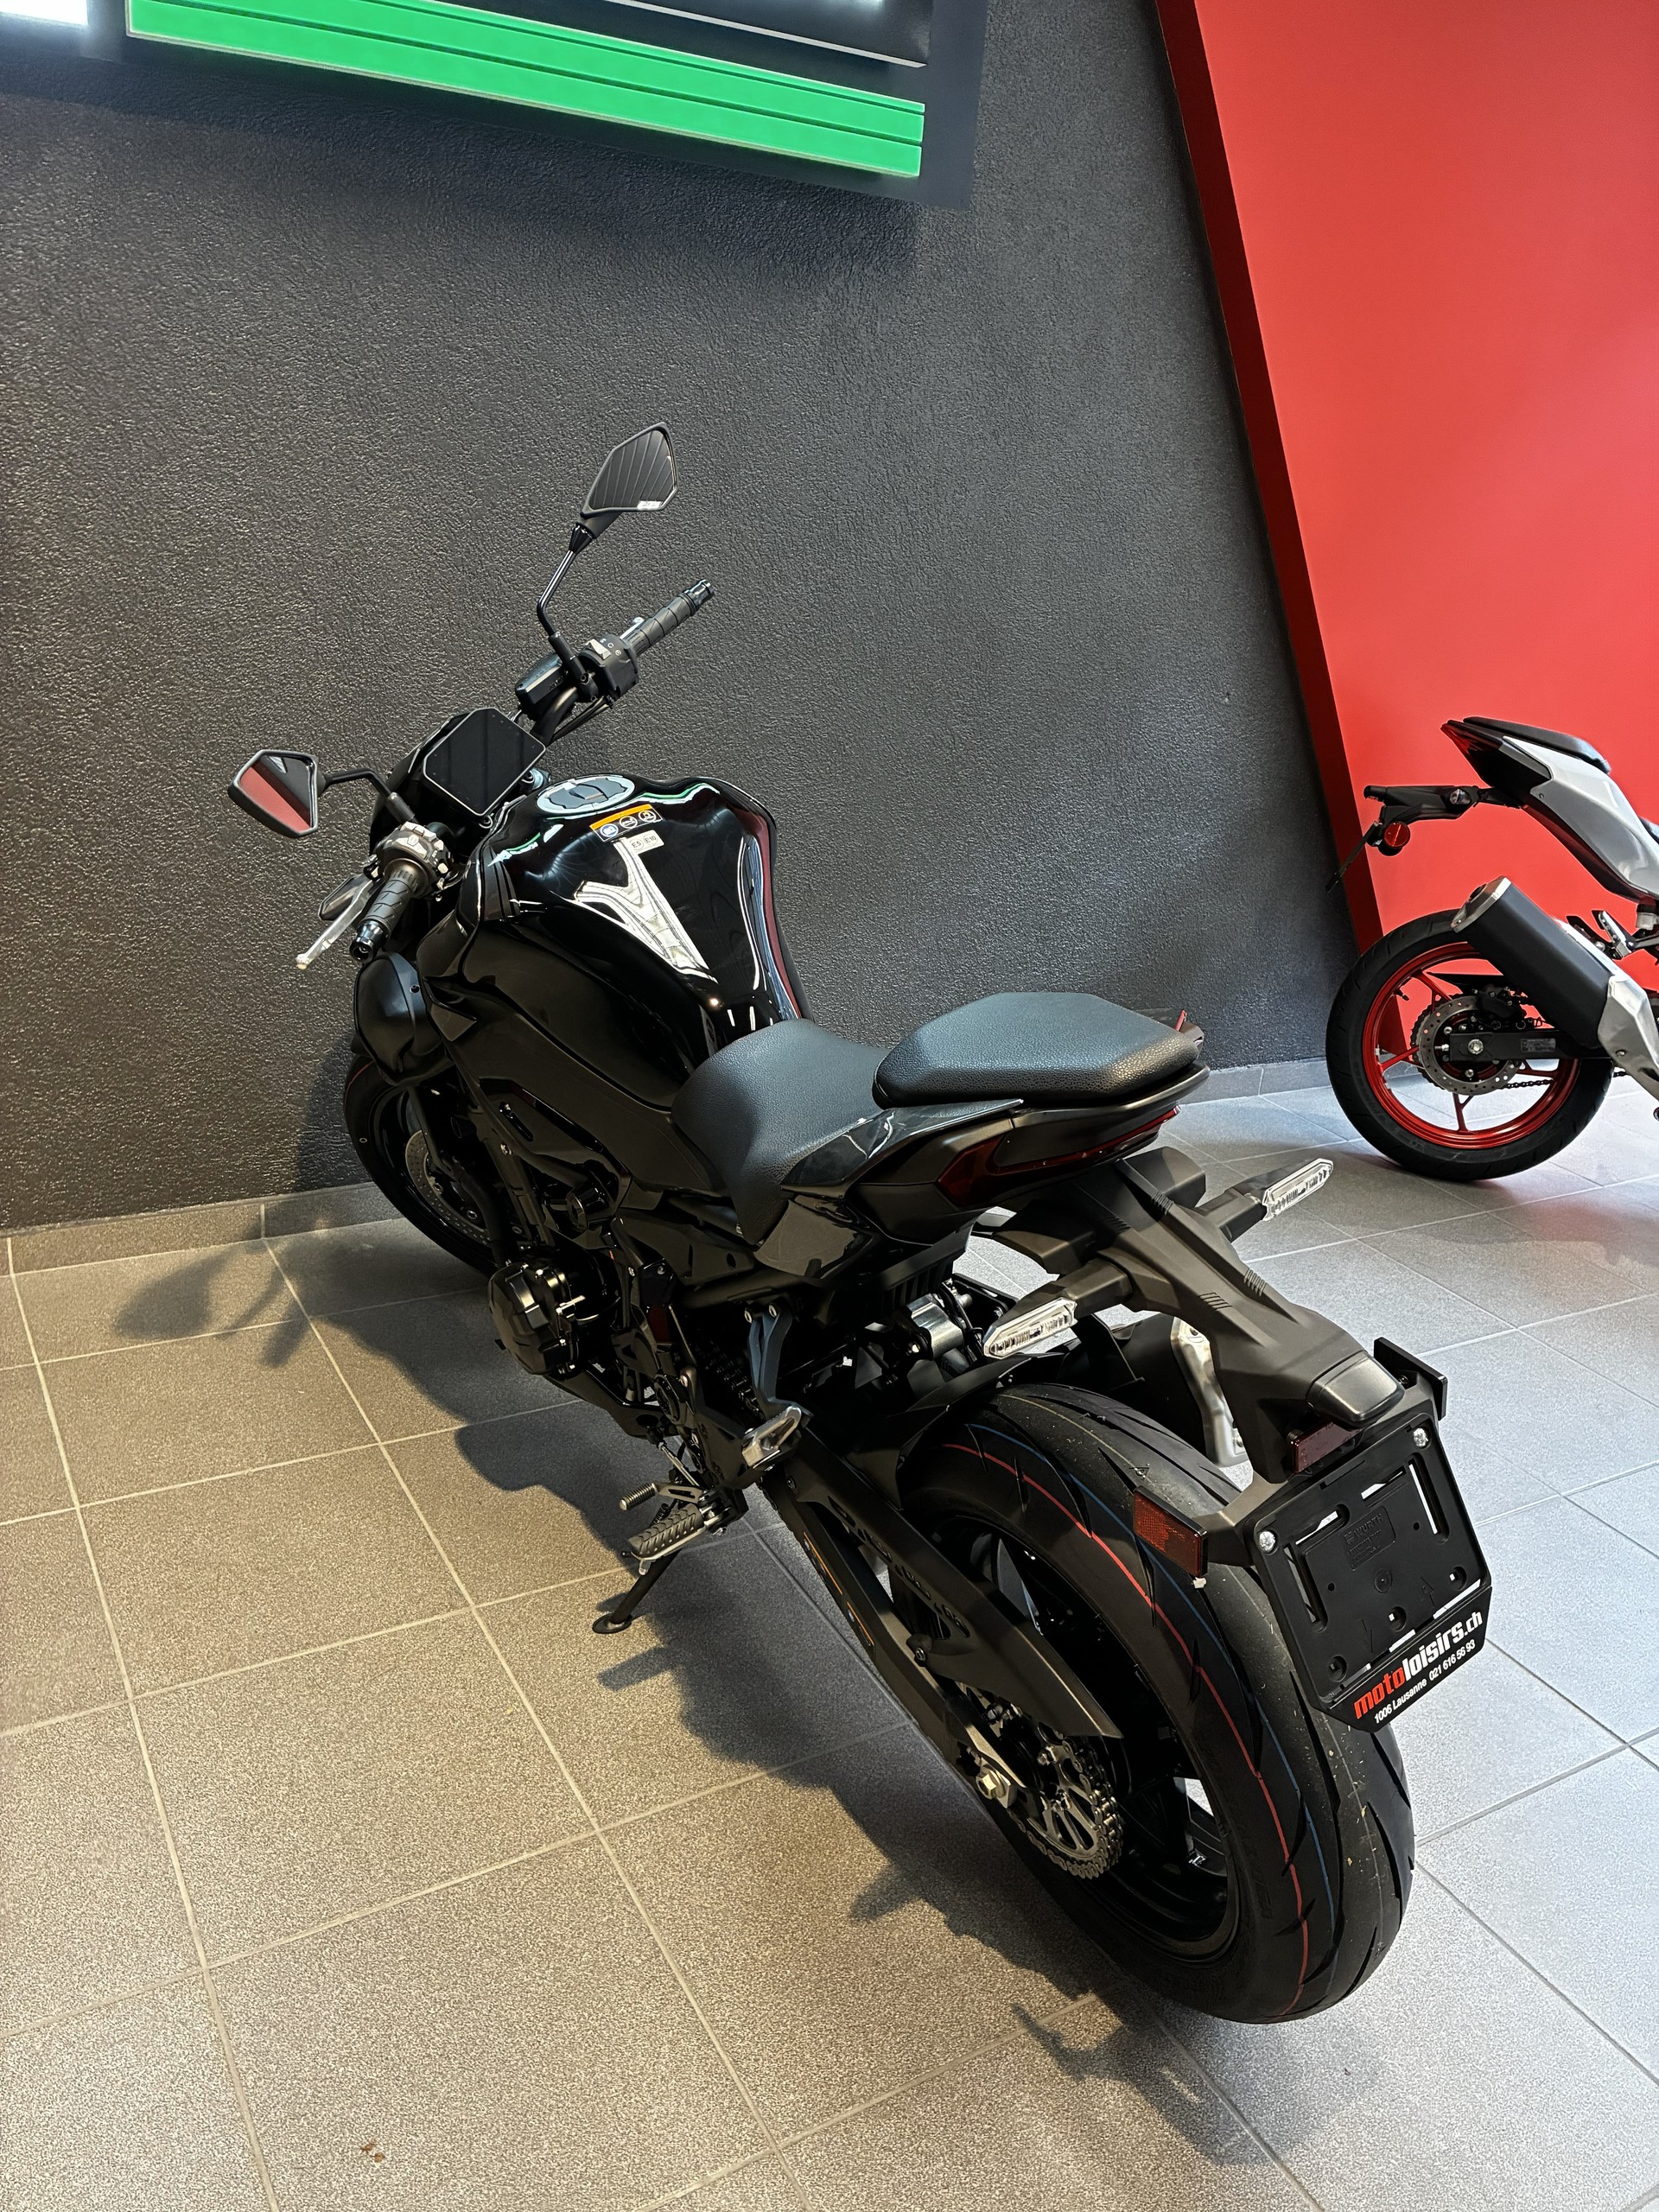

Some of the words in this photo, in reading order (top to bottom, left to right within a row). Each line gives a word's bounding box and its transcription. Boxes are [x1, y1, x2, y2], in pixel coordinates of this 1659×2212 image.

[1353, 1611, 1483, 1719] motoloisirs.ch
[1374, 1703, 1393, 1724] 1006
[1392, 1679, 1427, 1711] Lausanne
[1428, 1664, 1442, 1681] 021
[1442, 1653, 1457, 1670] 616
[1456, 1646, 1466, 1660] 56
[1465, 1639, 1476, 1653] 93
